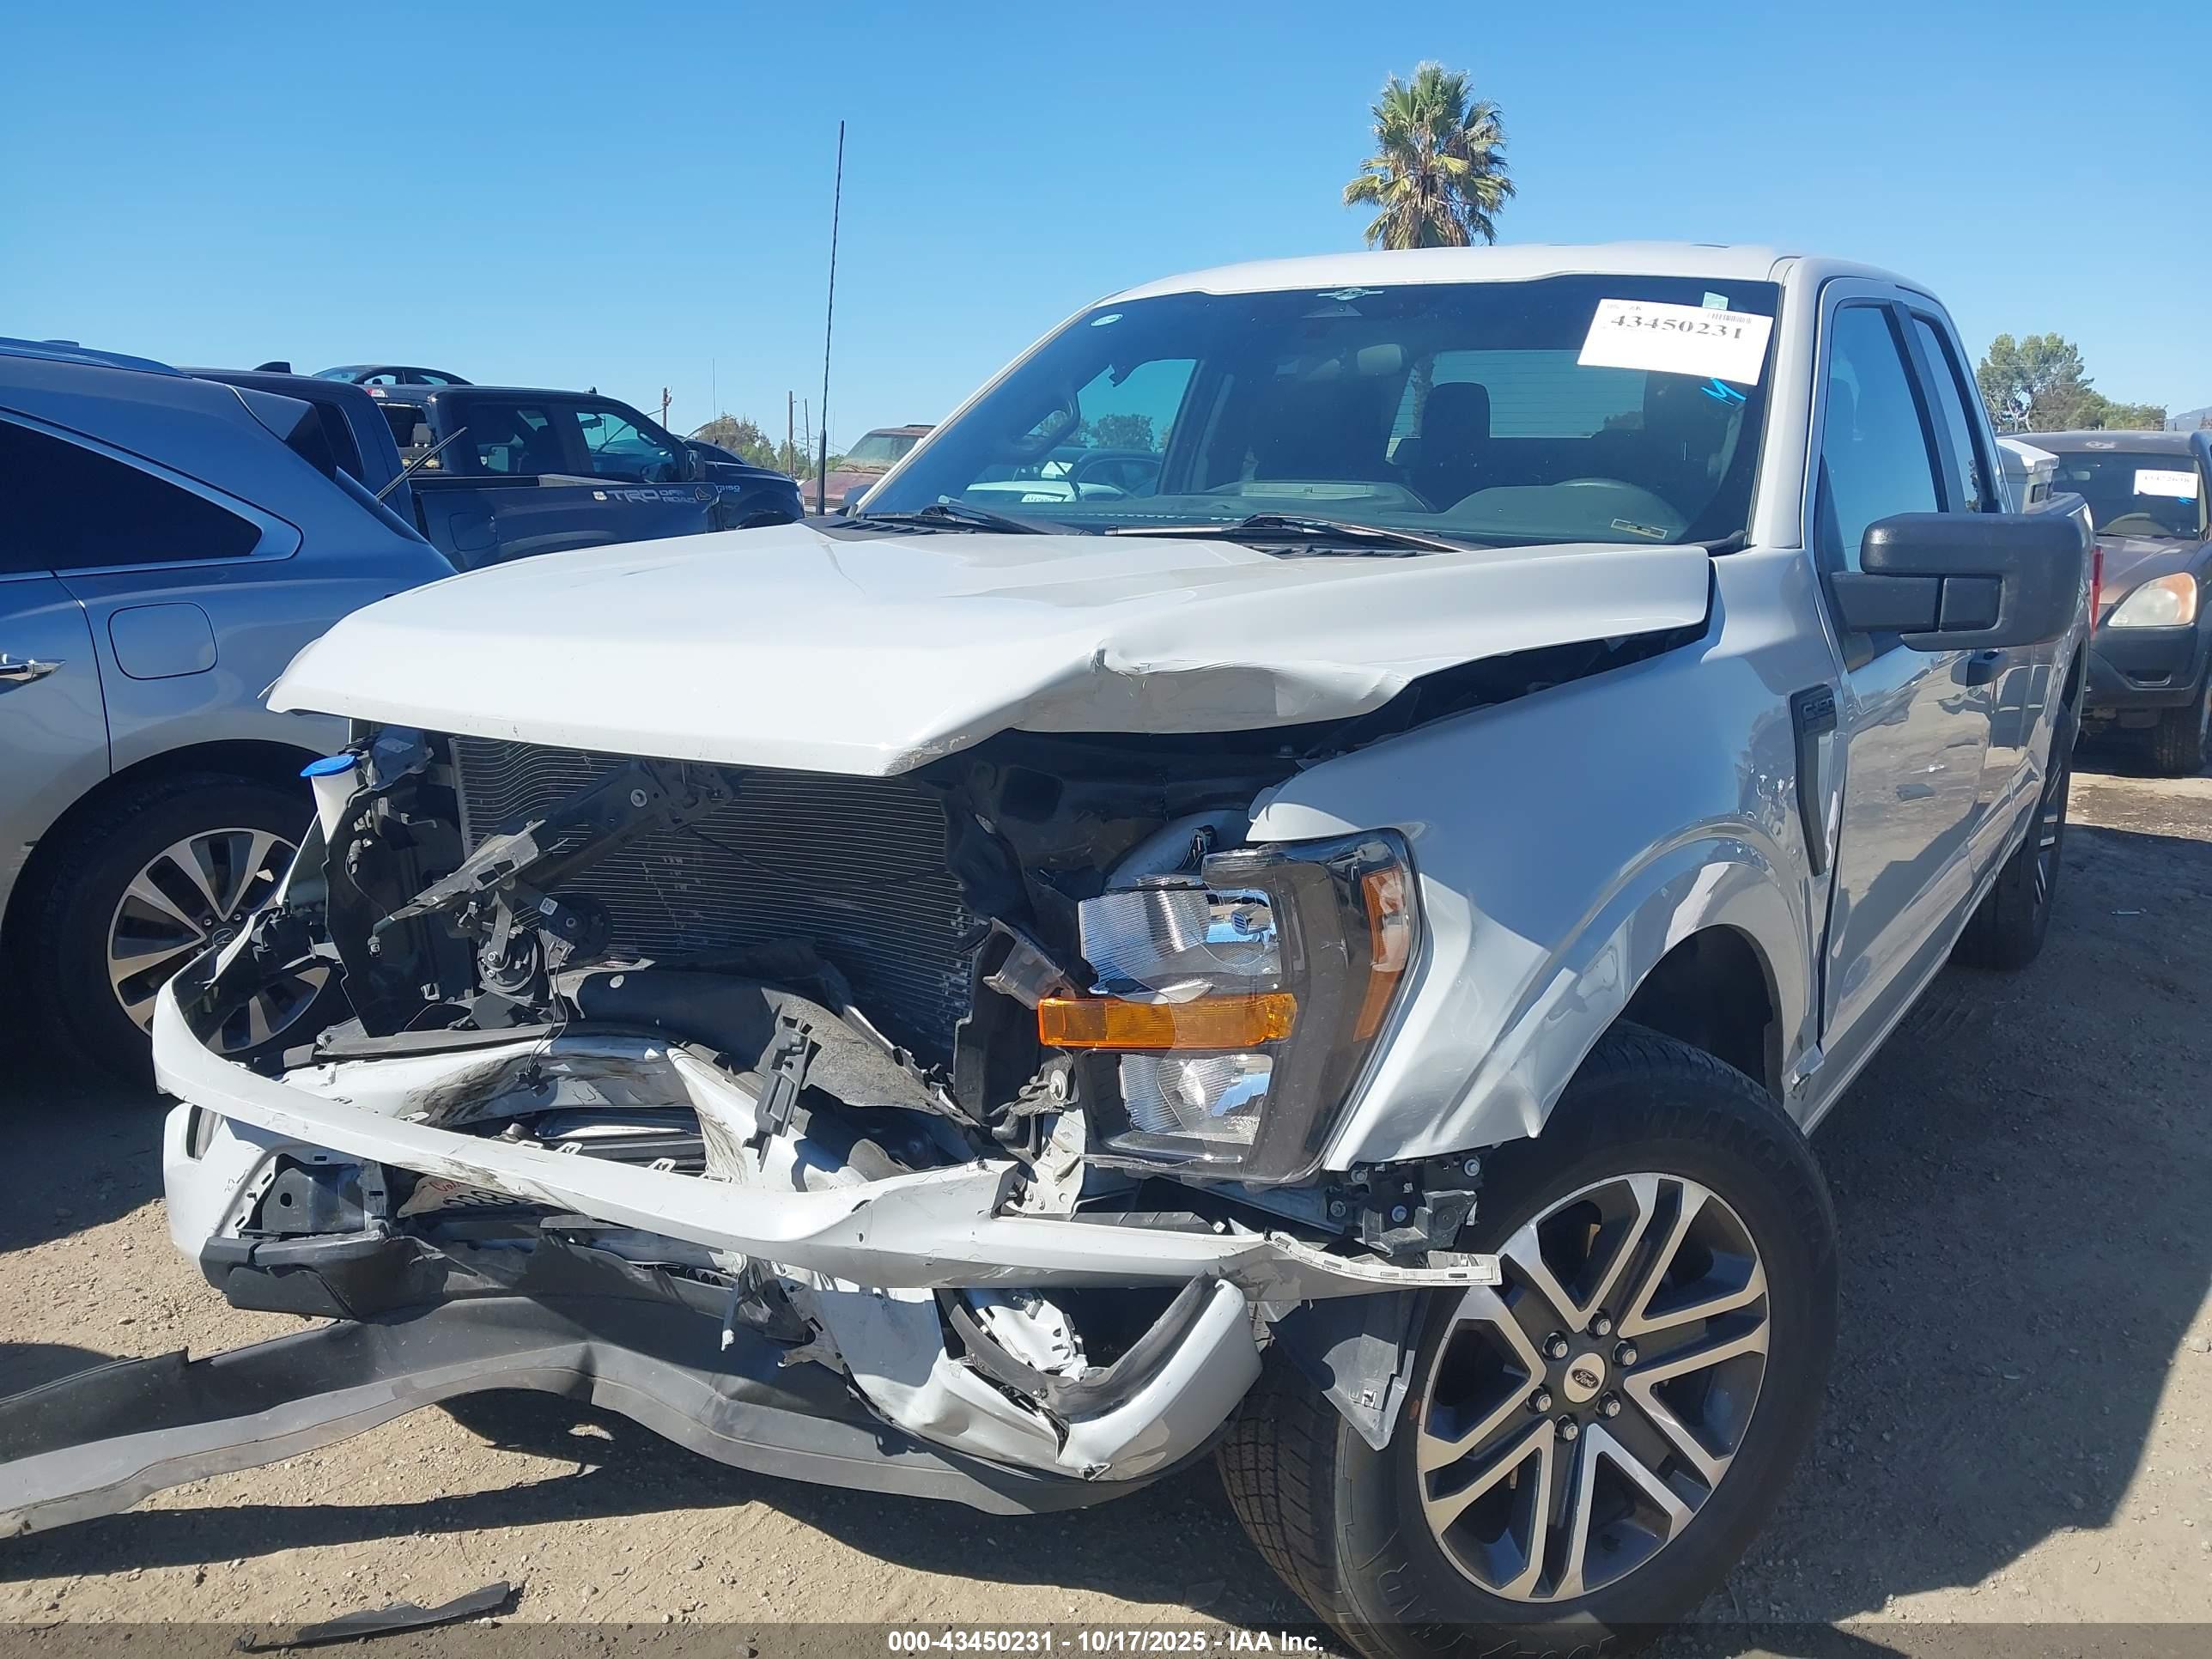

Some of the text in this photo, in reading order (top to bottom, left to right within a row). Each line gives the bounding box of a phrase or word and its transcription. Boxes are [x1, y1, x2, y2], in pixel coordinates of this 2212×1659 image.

[1611, 315, 1742, 339] 43450231
[606, 489, 659, 503] TRD
[1575, 1370, 1596, 1388] Ford
